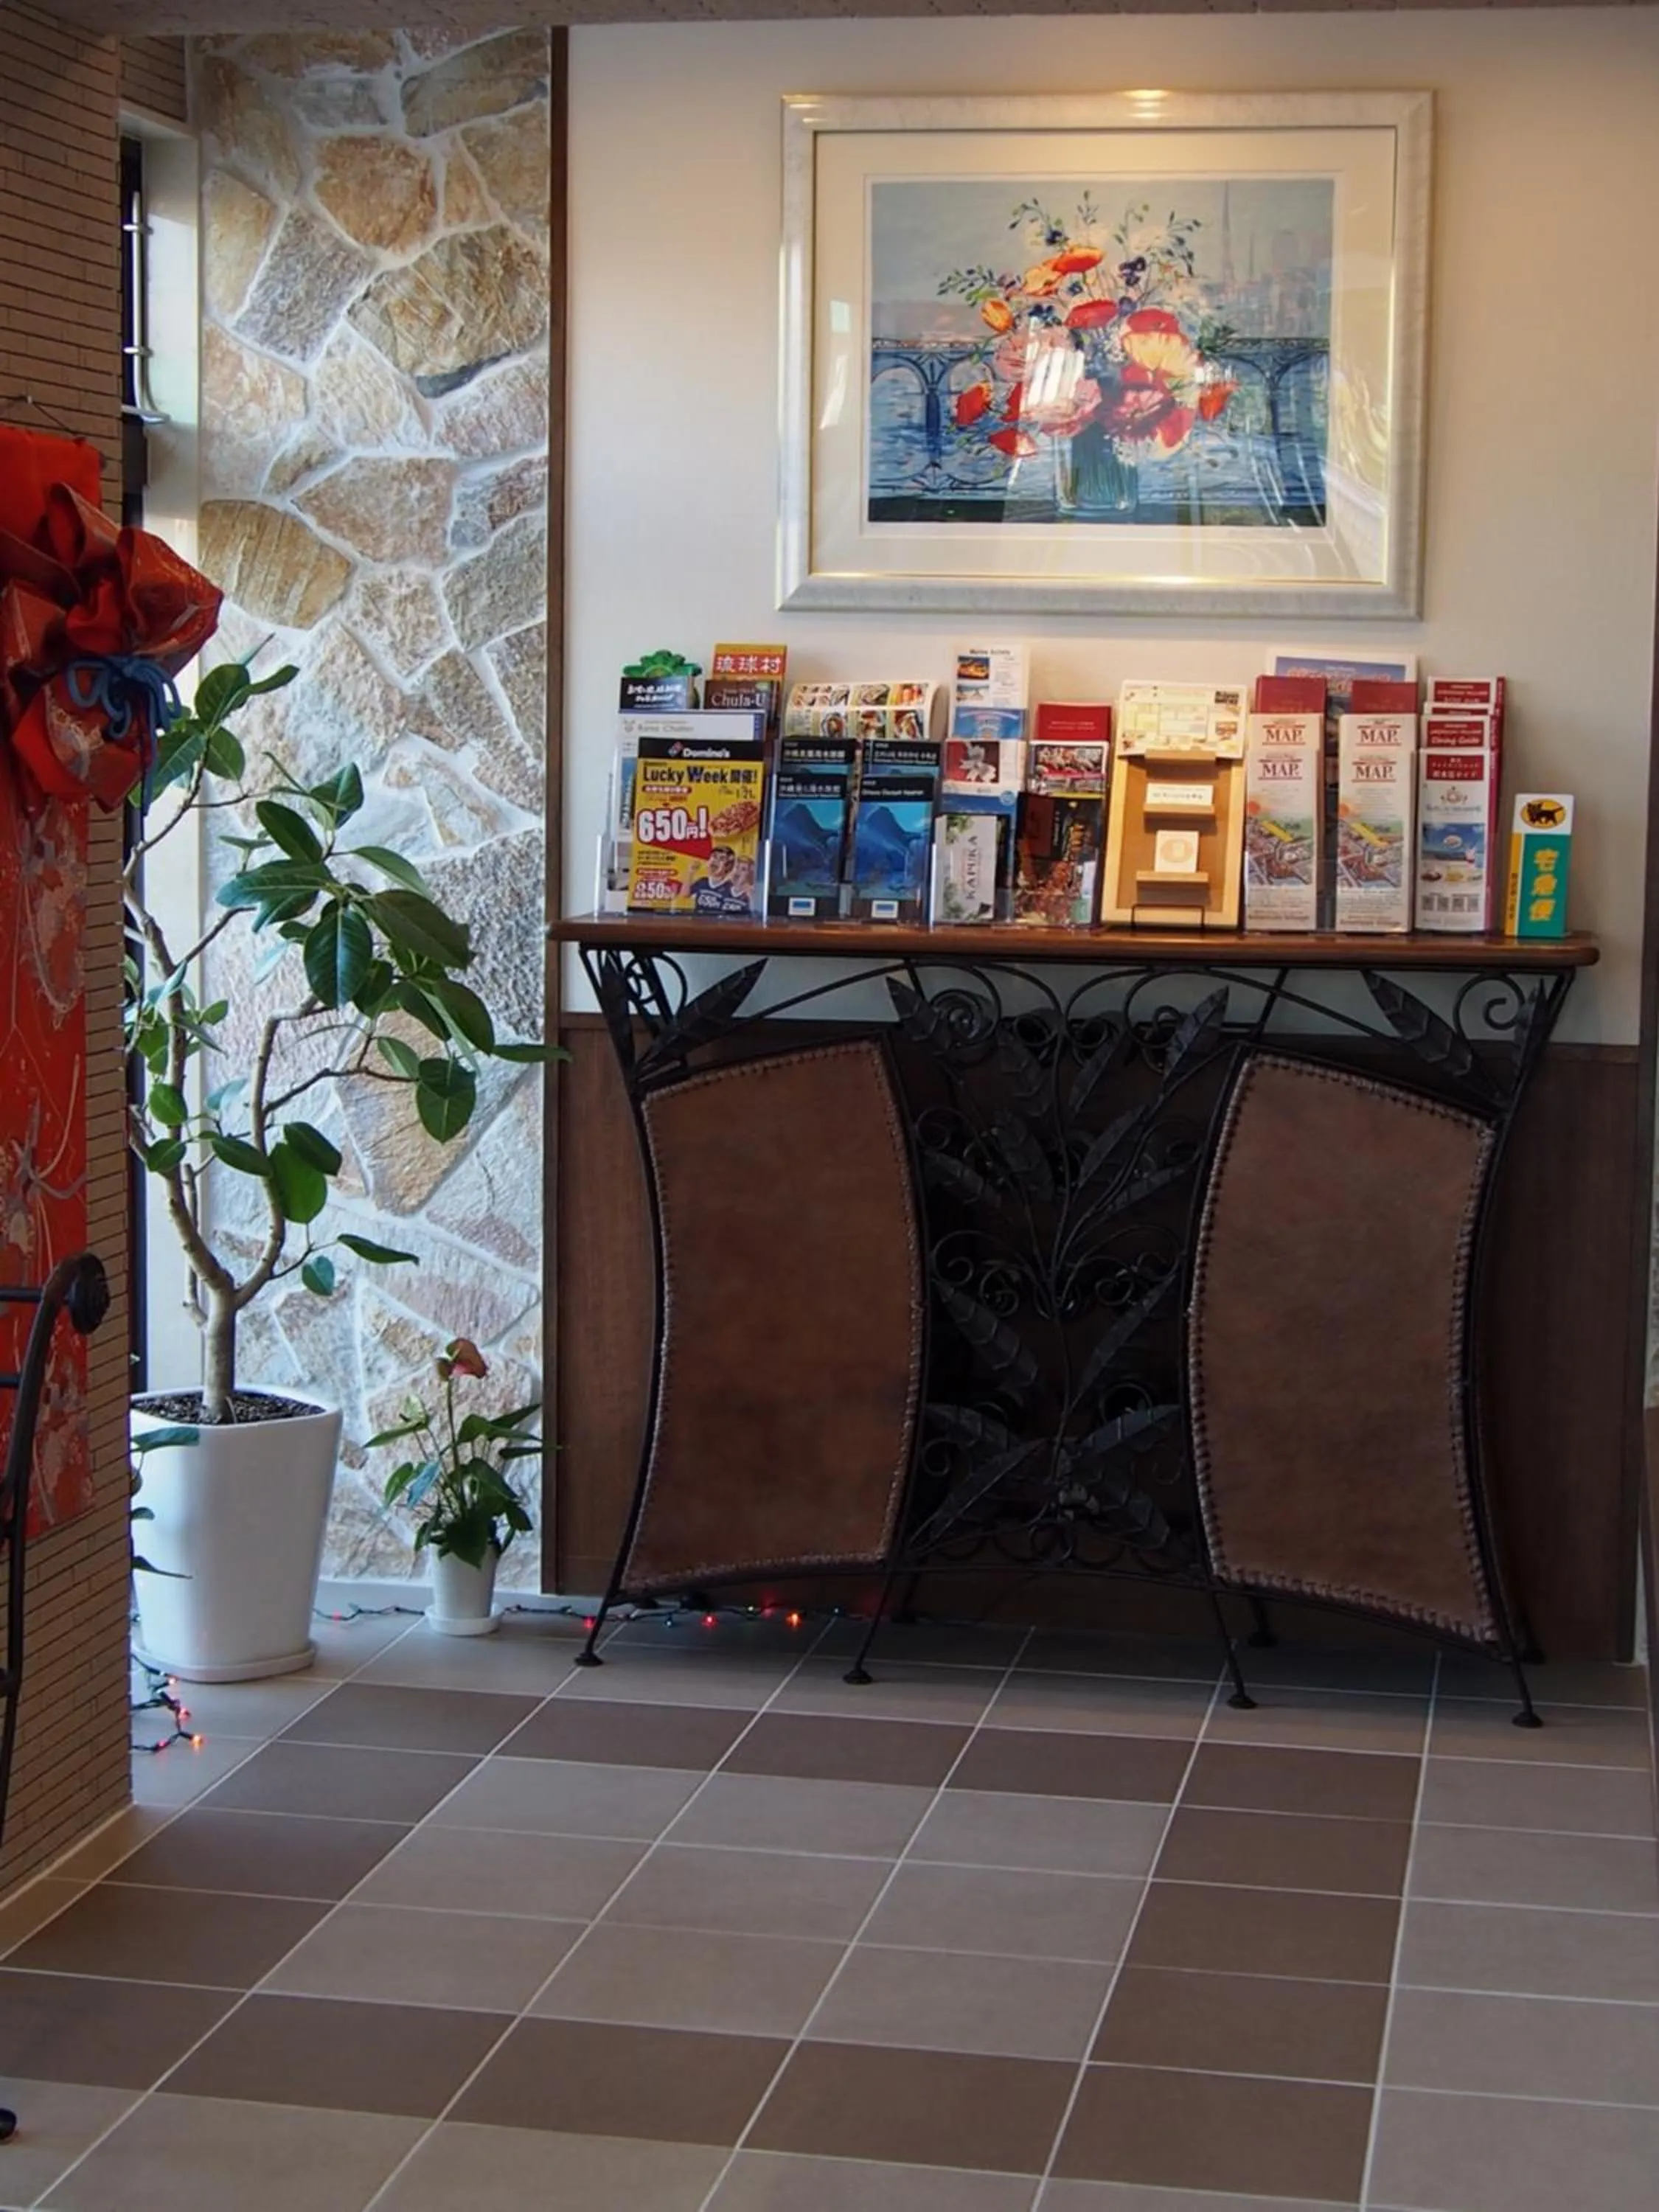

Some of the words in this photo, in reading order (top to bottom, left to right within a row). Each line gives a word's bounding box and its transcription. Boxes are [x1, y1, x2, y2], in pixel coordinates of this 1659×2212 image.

[716, 655, 781, 673] 琉球村
[683, 747, 730, 758] Domino's
[643, 767, 684, 785] Lucky
[687, 766, 728, 783] Week
